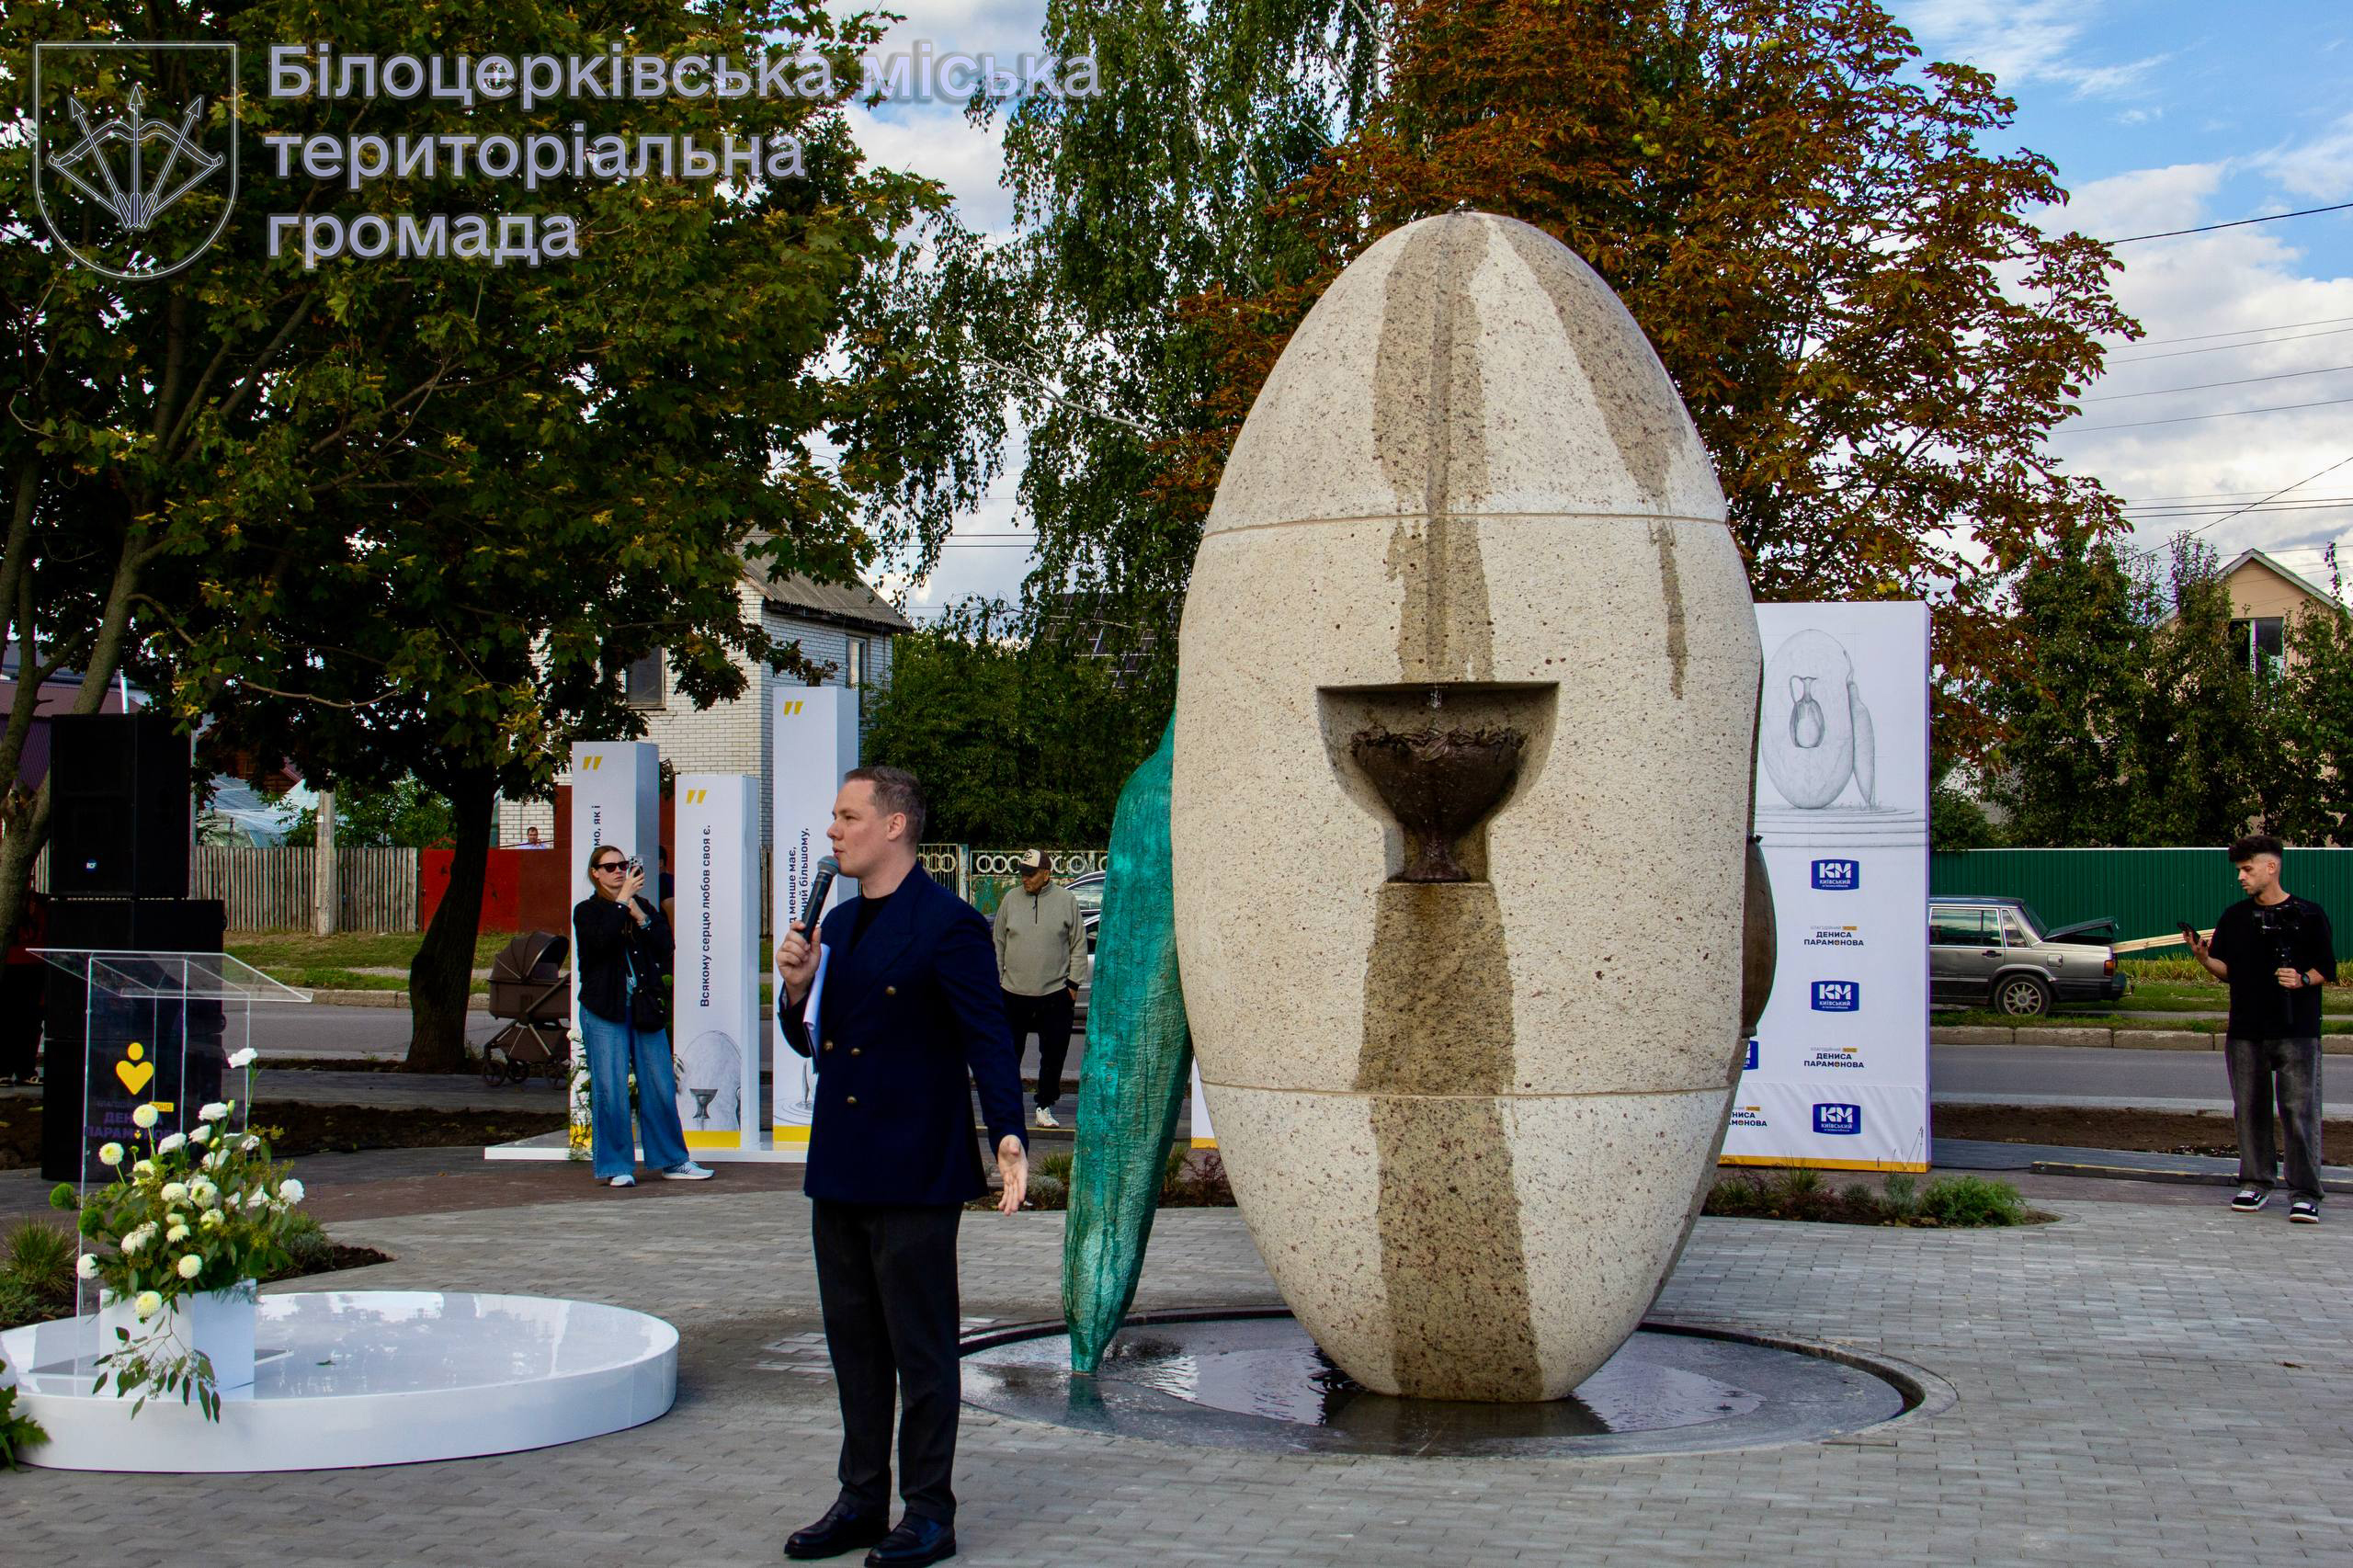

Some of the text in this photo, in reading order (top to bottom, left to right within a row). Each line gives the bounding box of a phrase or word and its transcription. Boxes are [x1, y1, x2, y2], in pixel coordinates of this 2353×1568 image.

[594, 812, 600, 824] як
[593, 828, 601, 846] мо,
[789, 846, 797, 872] має,
[799, 827, 811, 887] більшому,
[1819, 863, 1851, 879] КМ
[699, 824, 712, 1007] Всякому серцю любов своя є.
[1819, 984, 1851, 1000] КМ
[1803, 1060, 1865, 1068] ПАРАМОНОВА
[1821, 1107, 1853, 1123] КМ
